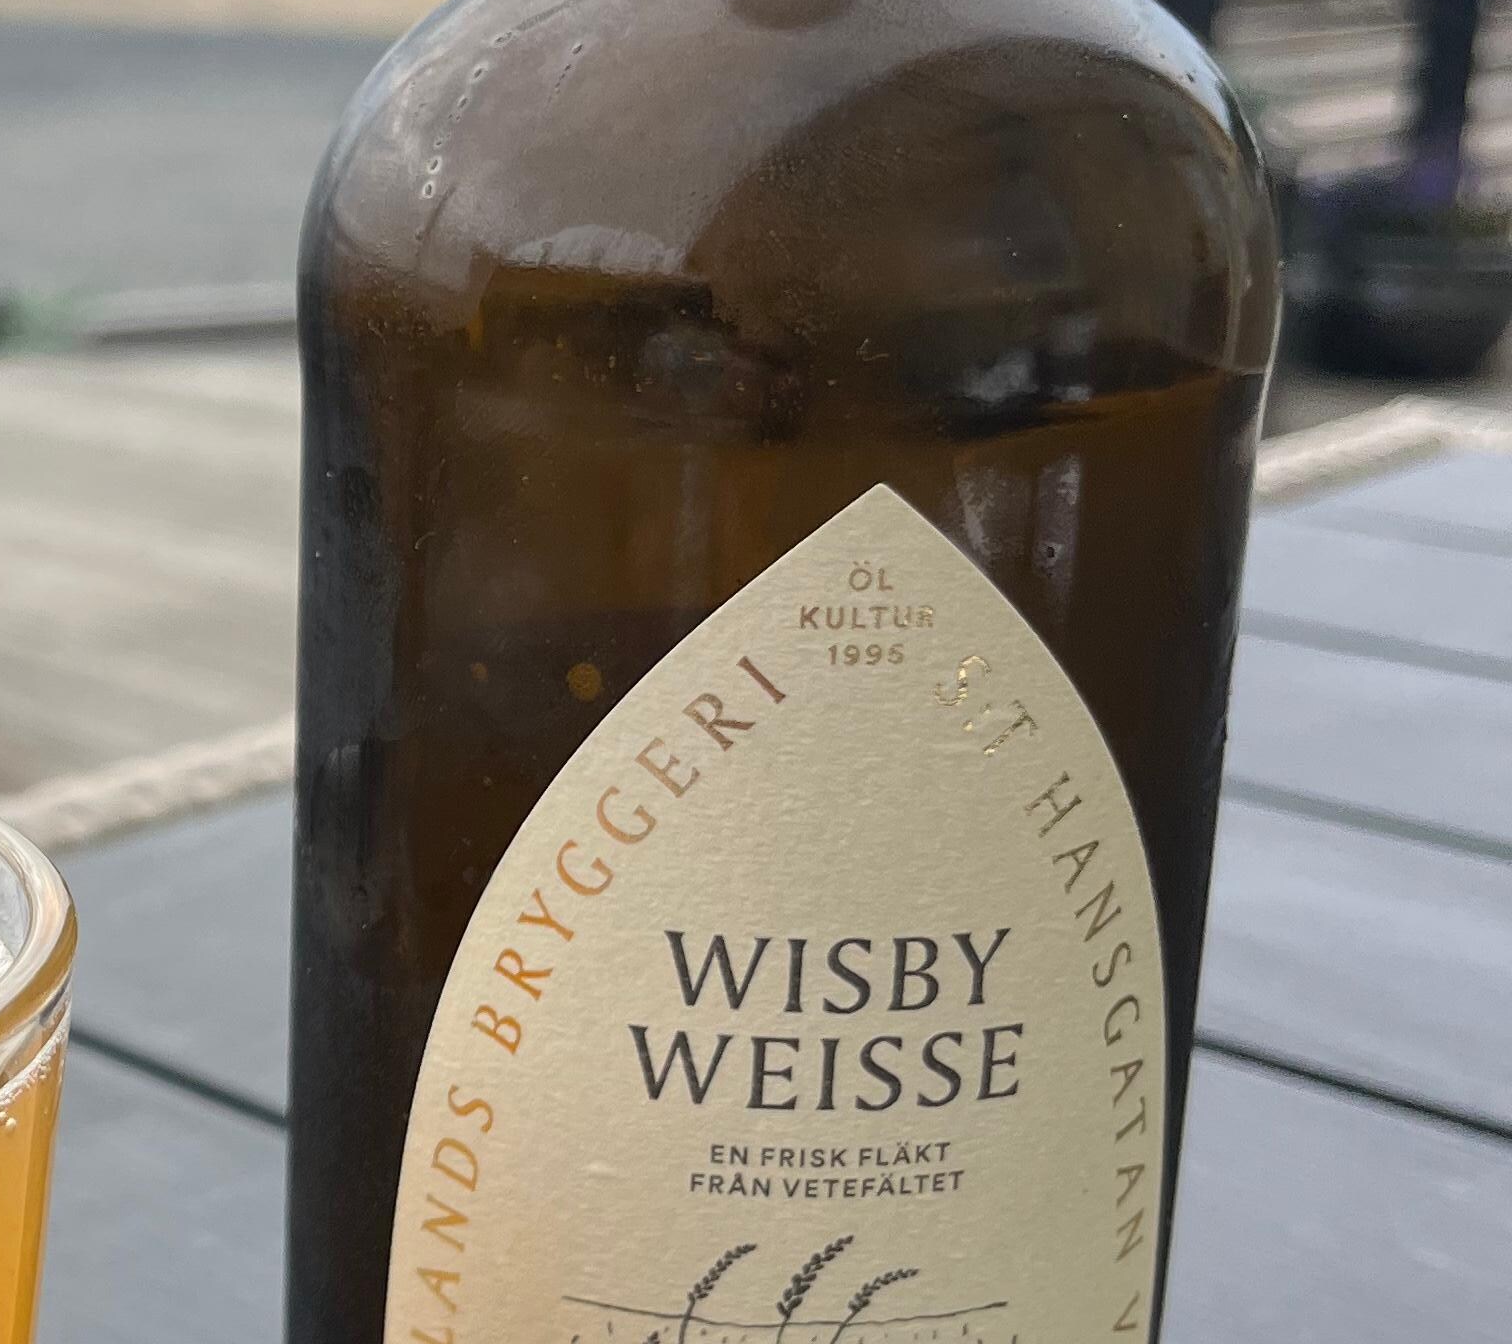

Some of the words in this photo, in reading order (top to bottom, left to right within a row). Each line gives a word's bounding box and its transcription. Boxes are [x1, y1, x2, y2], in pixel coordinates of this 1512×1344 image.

[848, 561, 893, 592] ÖL
[800, 605, 935, 629] KULTUR
[828, 644, 904, 665] 1995
[470, 655, 787, 1054] BRYGGERI
[664, 927, 1011, 1014] WISBY
[1024, 771, 1147, 1262] HANSGATAN
[627, 1023, 1024, 1111] WEISSE
[711, 1145, 748, 1164] EN
[760, 1145, 846, 1168] FRISK
[858, 1141, 951, 1166] FLÄKT
[690, 1172, 771, 1197] FRÅN
[784, 1170, 965, 1198] VETEFÄLTET
